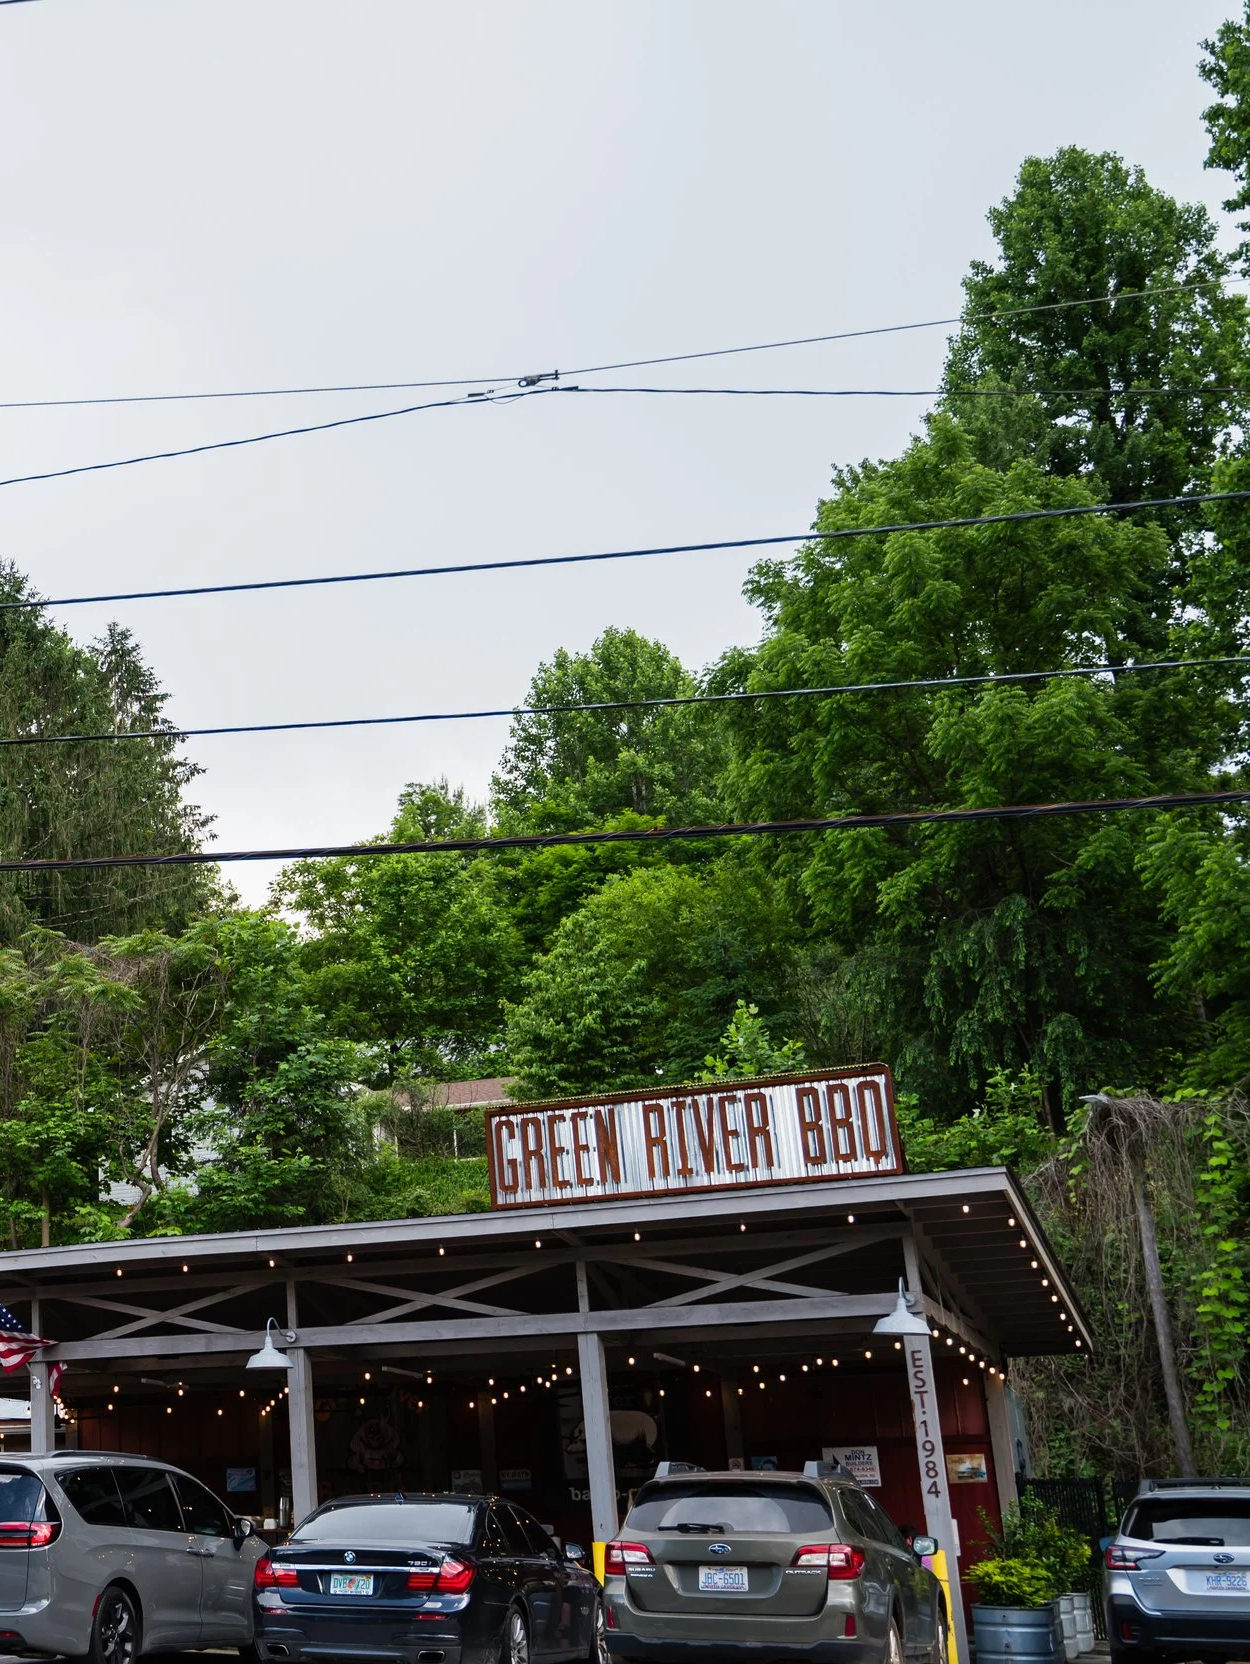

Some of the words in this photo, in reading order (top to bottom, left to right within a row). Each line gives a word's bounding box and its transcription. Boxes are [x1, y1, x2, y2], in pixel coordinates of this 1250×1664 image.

[495, 1108, 621, 1193] GREEN
[643, 1091, 775, 1180] RIVER
[796, 1080, 887, 1166] BBQ
[920, 1419, 941, 1498] 1984
[333, 1577, 348, 1589] DVB
[702, 1572, 745, 1585] JBC-6501
[1206, 1575, 1247, 1587] KHR-9226
